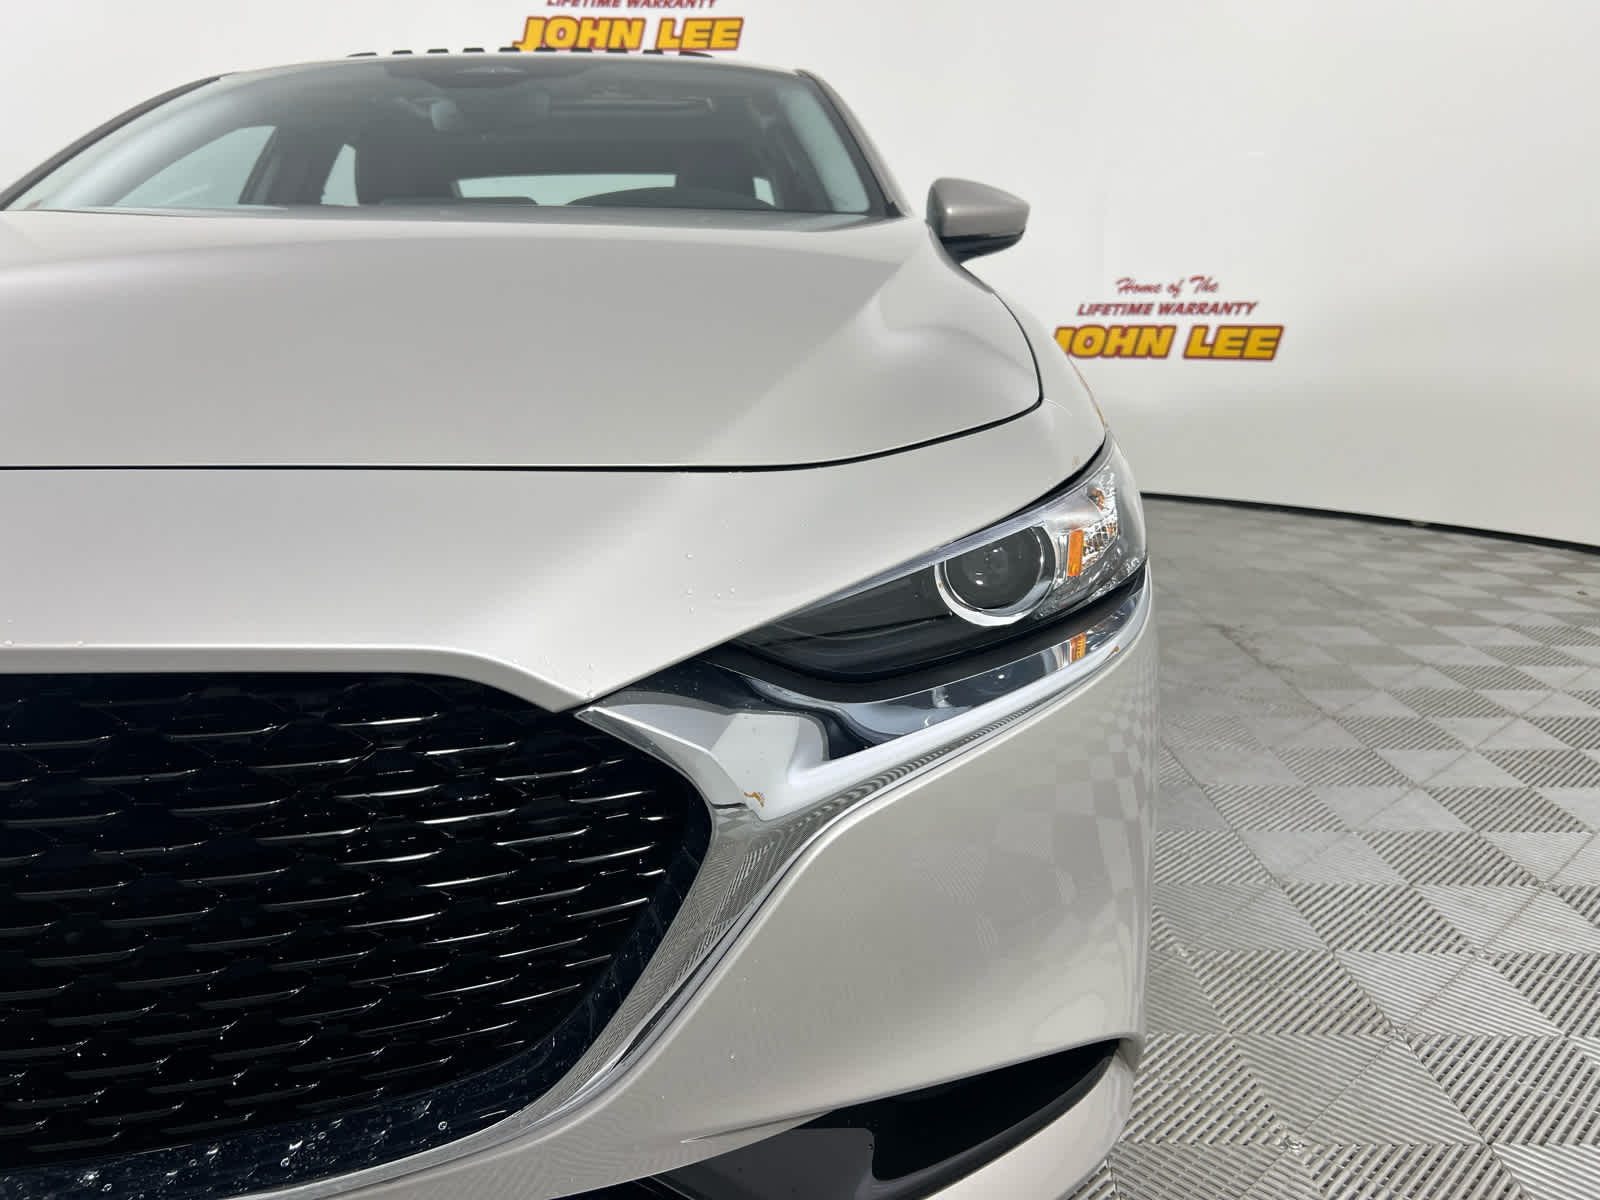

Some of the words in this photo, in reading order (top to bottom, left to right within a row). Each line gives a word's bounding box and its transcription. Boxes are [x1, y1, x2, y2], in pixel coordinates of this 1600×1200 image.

[512, 16, 646, 51] JOHN
[655, 17, 744, 51] LEE
[1115, 277, 1162, 294] Home
[1166, 279, 1185, 298] of
[1189, 275, 1219, 293] The
[1077, 302, 1154, 316] LIFETIME
[1157, 301, 1257, 316] WARRANTY
[1183, 324, 1284, 361] LEE
